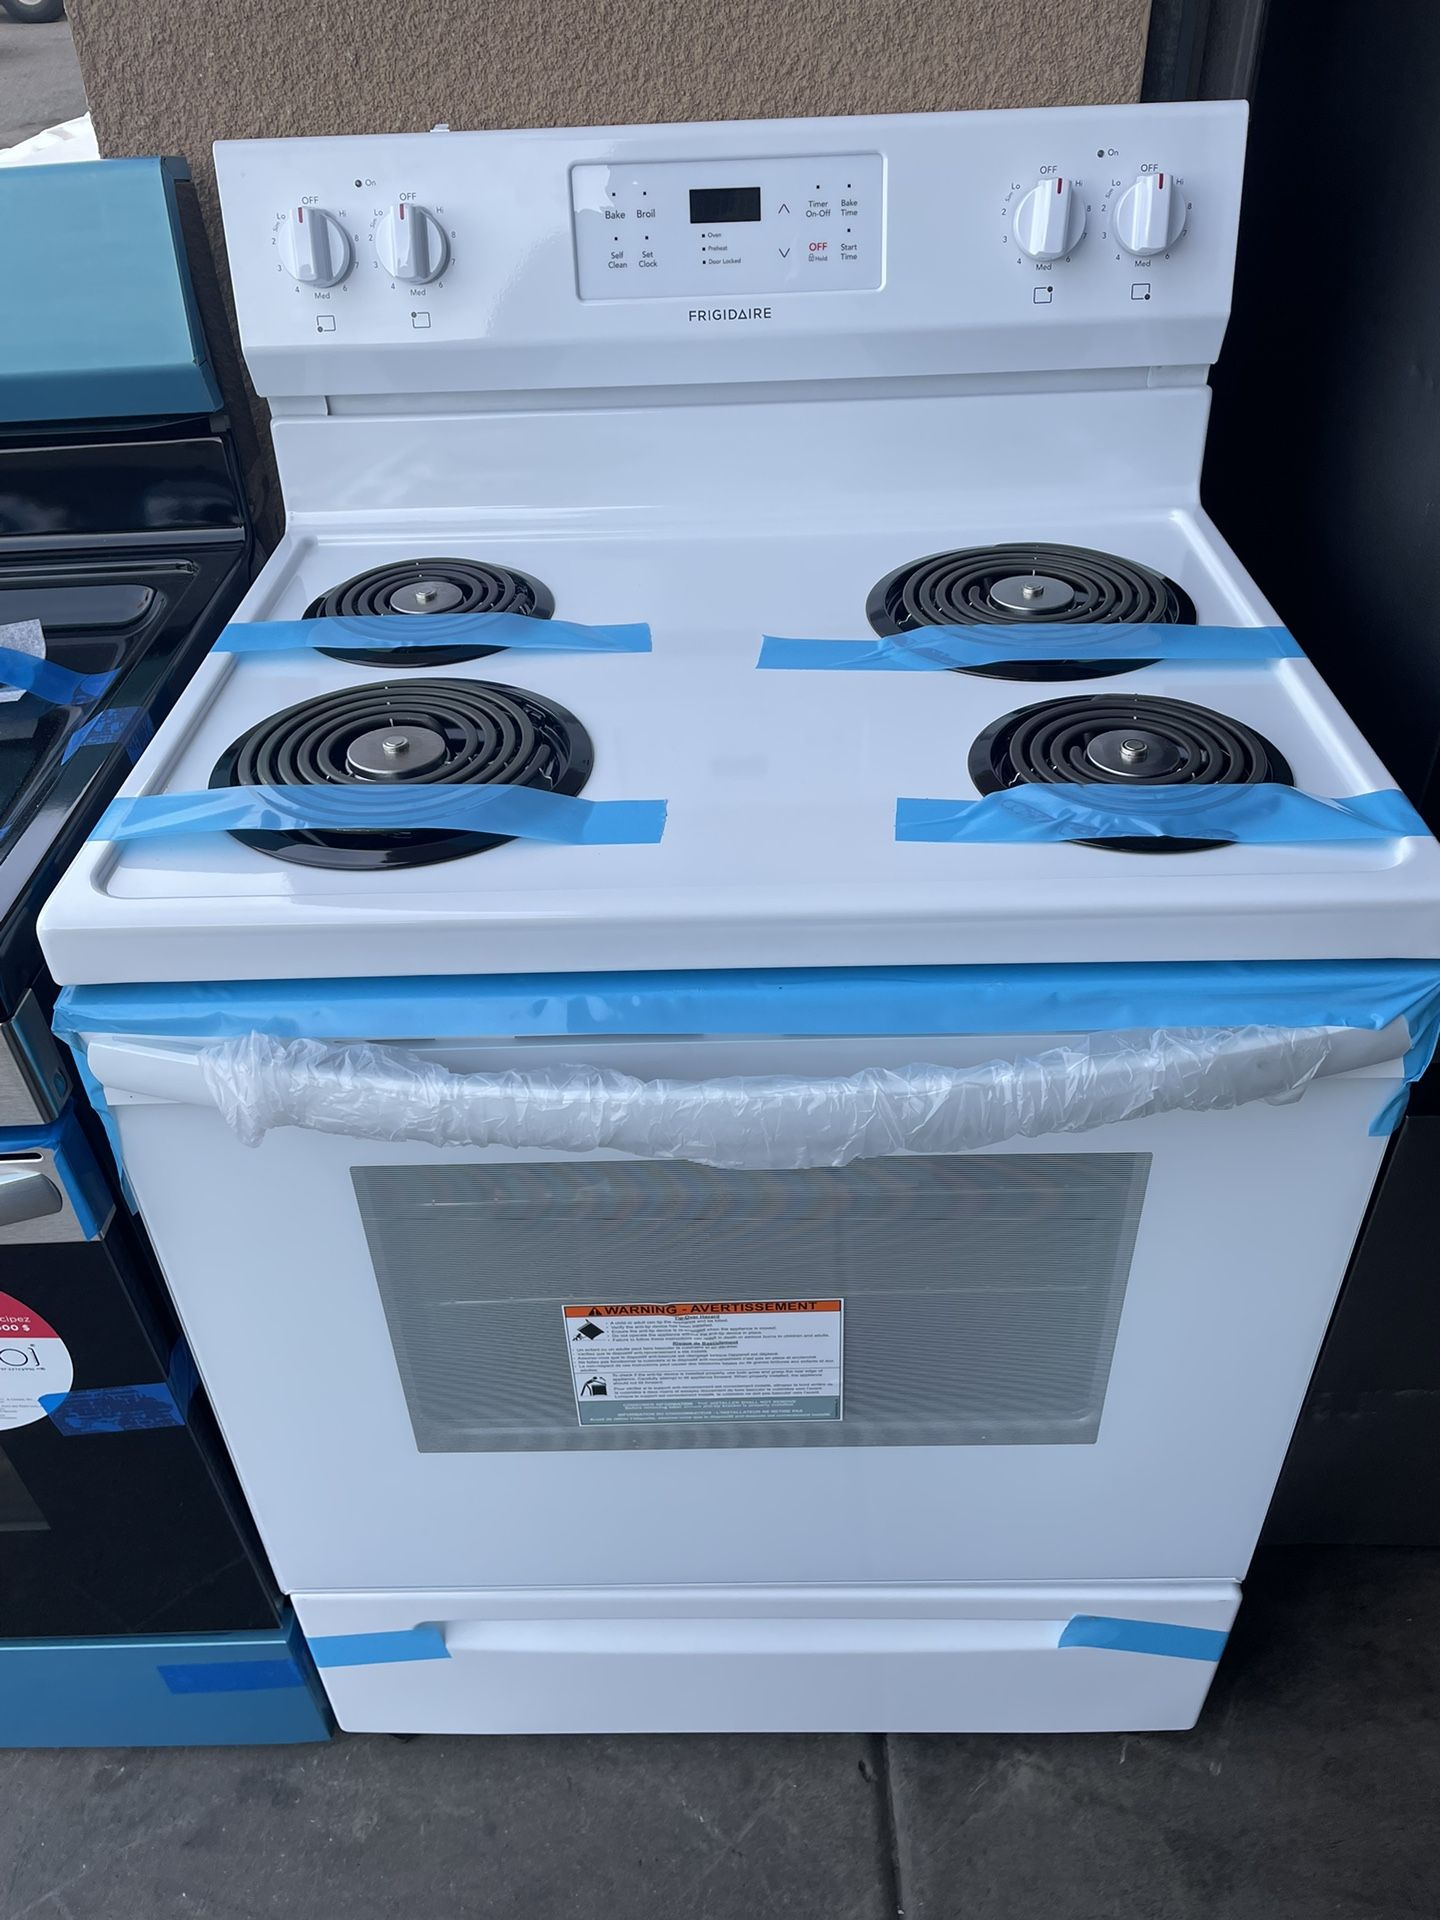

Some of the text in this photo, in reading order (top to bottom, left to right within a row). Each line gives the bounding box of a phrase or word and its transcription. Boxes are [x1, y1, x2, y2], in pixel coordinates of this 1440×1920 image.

[1108, 148, 1119, 157] On
[1040, 165, 1058, 174] OFF
[1140, 164, 1159, 172] OFF
[365, 179, 377, 187] On
[1112, 179, 1121, 187] Lo
[301, 196, 319, 205] OFF
[400, 192, 417, 201] OFF
[808, 200, 829, 208] Timer
[841, 199, 858, 207] Bake
[374, 209, 384, 217] Lo
[436, 206, 444, 214] Hi
[636, 208, 656, 219] Broil
[805, 209, 831, 218] On-Off
[840, 208, 858, 216] Time
[276, 212, 286, 220] Lo
[604, 209, 626, 220] Bake
[808, 242, 828, 251] OFF
[840, 243, 858, 252] Start
[610, 250, 624, 260] Self
[641, 250, 654, 259] Set
[840, 252, 858, 261] Time
[608, 261, 628, 269] Clean
[638, 260, 658, 268] Clock
[1035, 263, 1052, 271] Med
[1135, 260, 1151, 268] Med
[314, 292, 331, 300] Med
[410, 288, 426, 296] Med
[688, 307, 772, 322] FRIGIDAIRE
[604, 1304, 678, 1315] WARNING
[690, 1302, 817, 1313] AVERTISSEMENT
